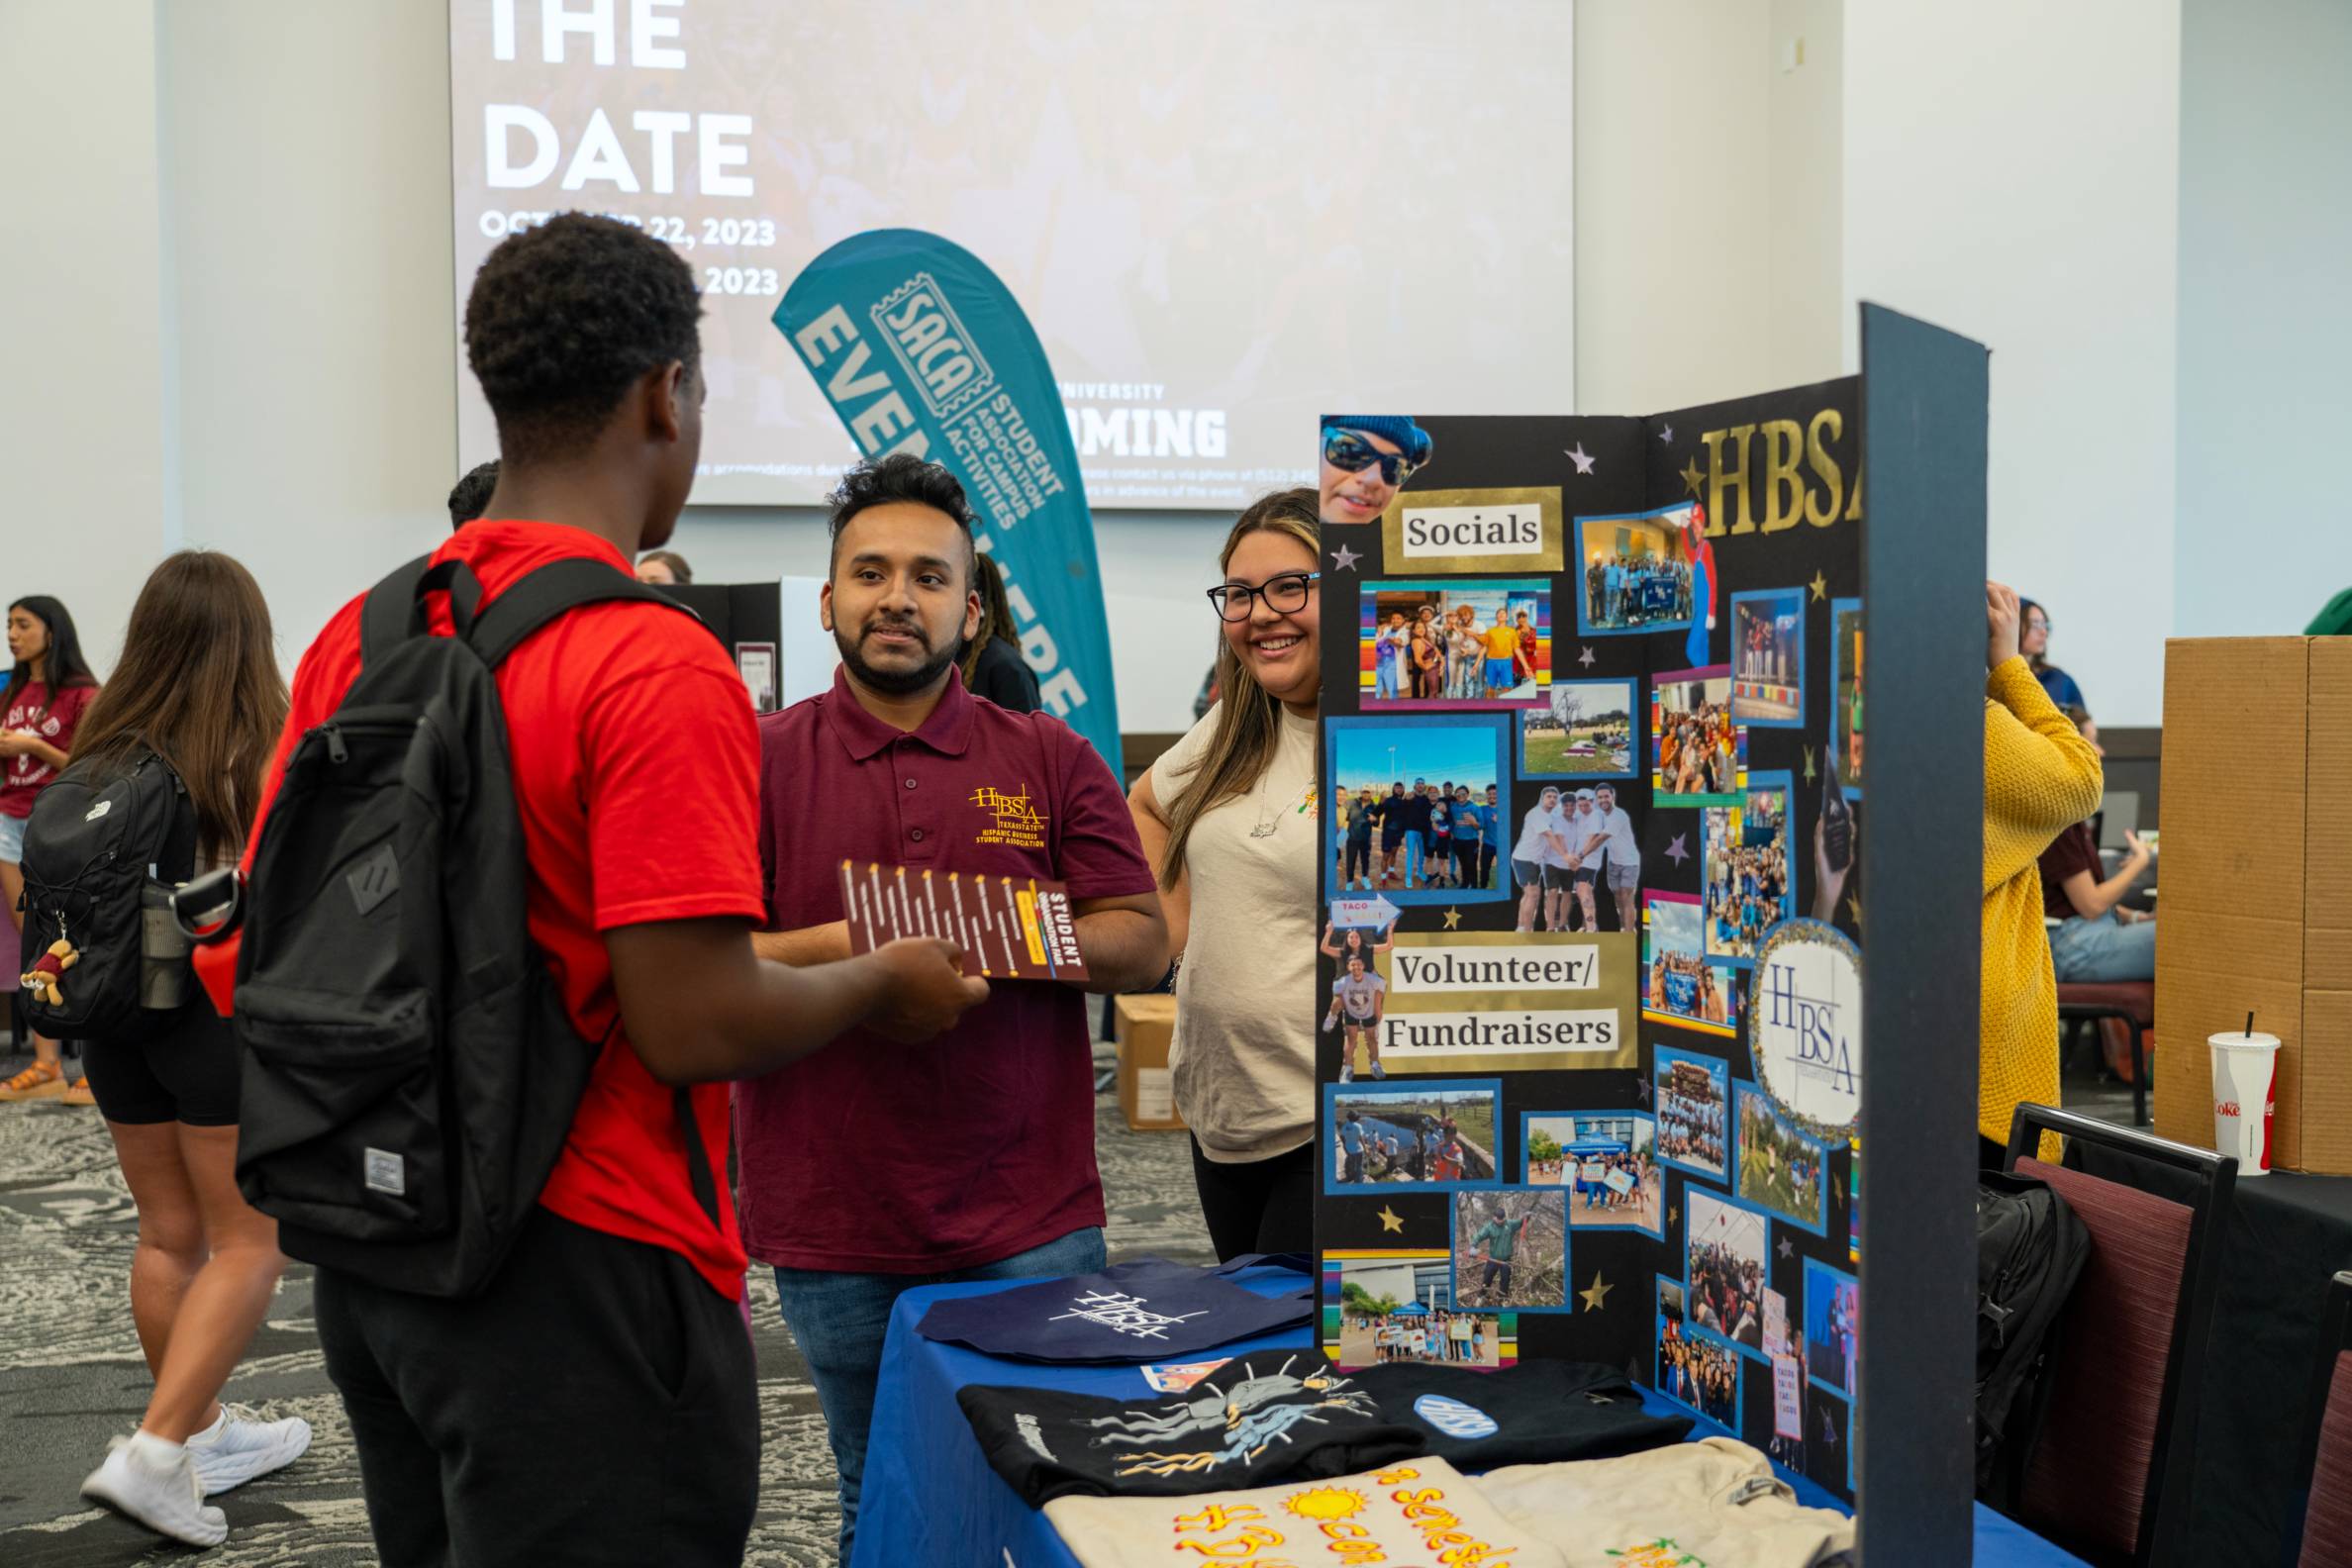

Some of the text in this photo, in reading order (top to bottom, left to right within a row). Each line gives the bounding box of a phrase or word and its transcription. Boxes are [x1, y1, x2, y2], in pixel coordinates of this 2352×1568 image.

[484, 104, 754, 197] DATE
[648, 216, 696, 250] 22,
[701, 218, 776, 246] 2023
[705, 266, 779, 295] 2023
[886, 293, 975, 400] SACA
[1057, 382, 1165, 401] NIVERSITY
[975, 407, 1046, 511] ASSOCIATION
[991, 394, 1066, 497] STUDENT
[944, 429, 1018, 531] ACTIVITIES
[961, 416, 1031, 520] FOR CAMPUS
[1406, 513, 1539, 547] Socials
[973, 786, 1042, 825] HBSA
[981, 829, 1038, 840] HISPANIC BUSINESS
[1005, 837, 1045, 848] ASSOCIATION
[1341, 902, 1369, 911] TACO
[1049, 892, 1083, 967] STUDENT
[1396, 952, 1594, 987] Volunteer/
[1385, 1015, 1613, 1047] Fundraisers
[1769, 963, 1856, 1096] HBSA
